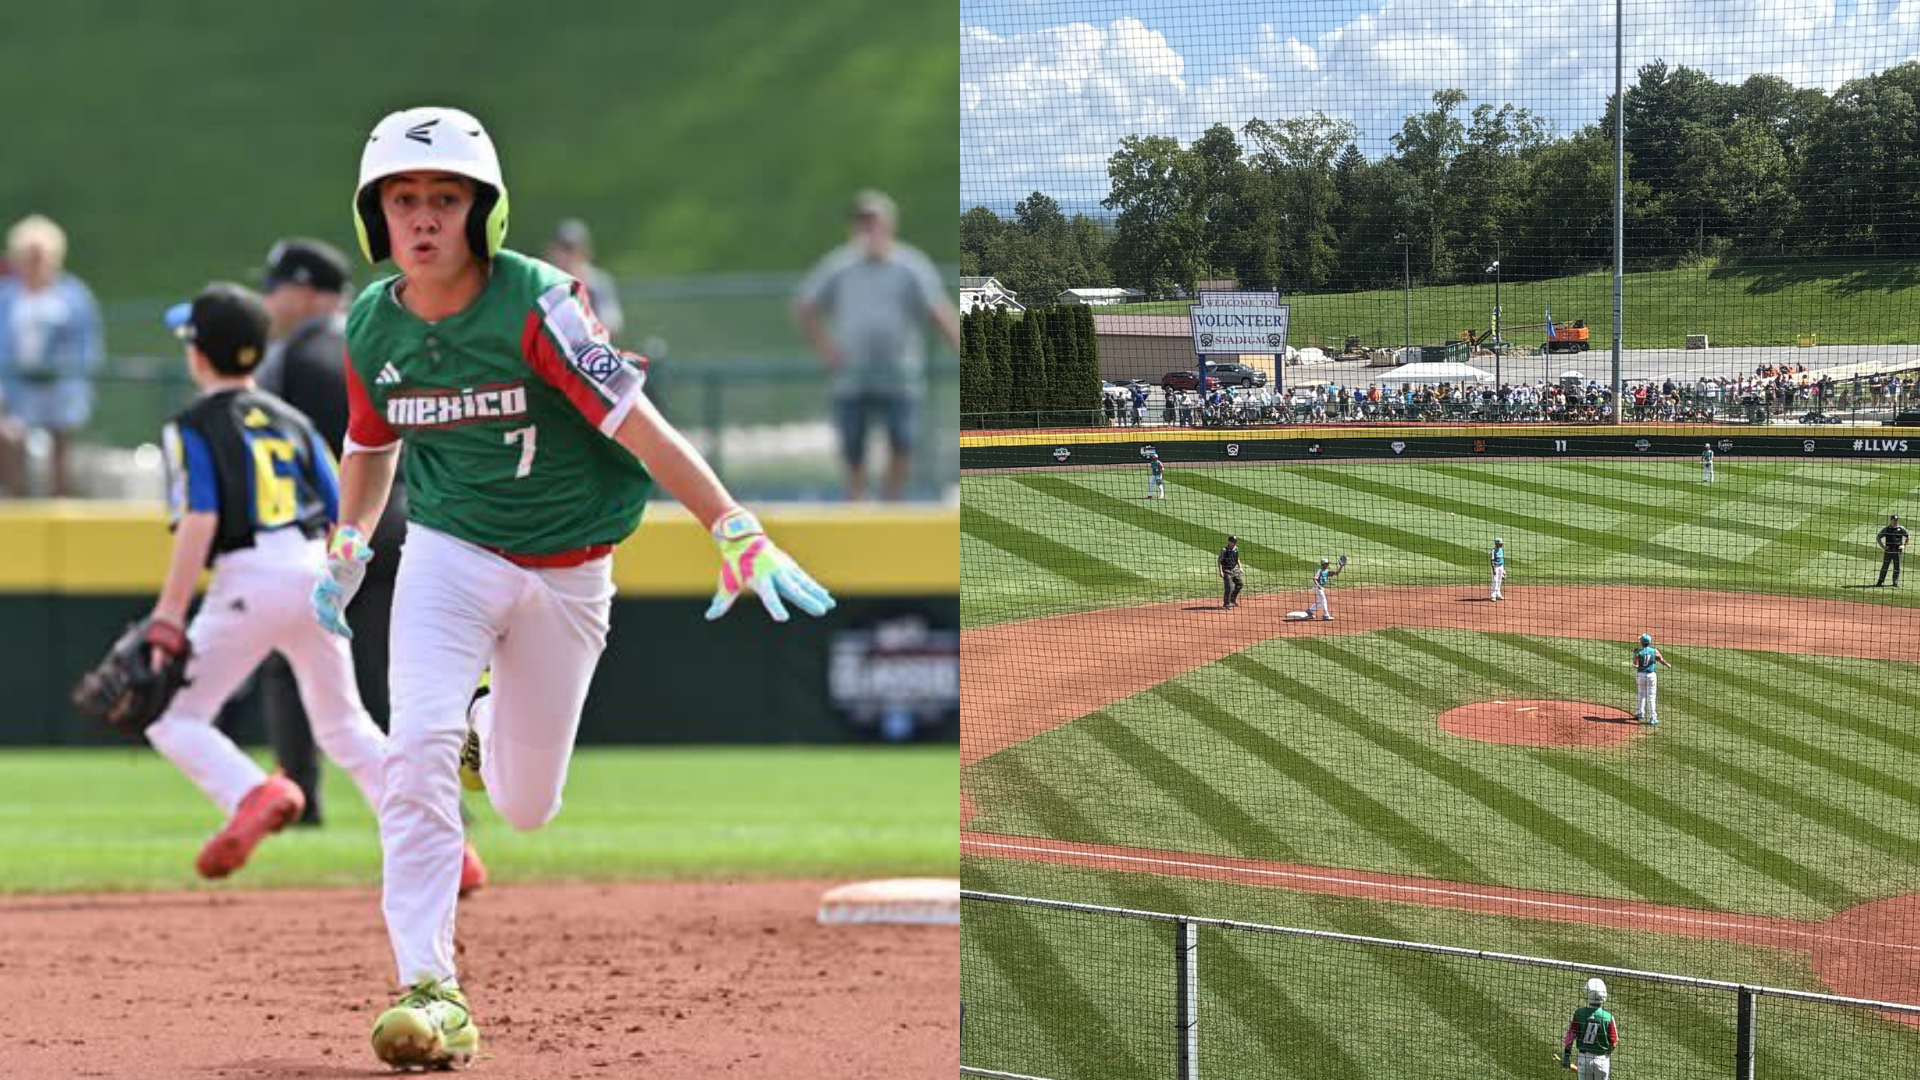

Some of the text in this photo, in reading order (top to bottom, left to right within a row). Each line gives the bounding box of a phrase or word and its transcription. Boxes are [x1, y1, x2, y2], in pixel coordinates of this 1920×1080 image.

[1205, 299, 1273, 307] WELCOME TO
[1196, 314, 1283, 327] VOLUNTEER
[1215, 336, 1265, 345] STADIUM
[504, 424, 536, 478] 7
[1555, 440, 1567, 452] 11
[1852, 439, 1908, 452] #LLWS
